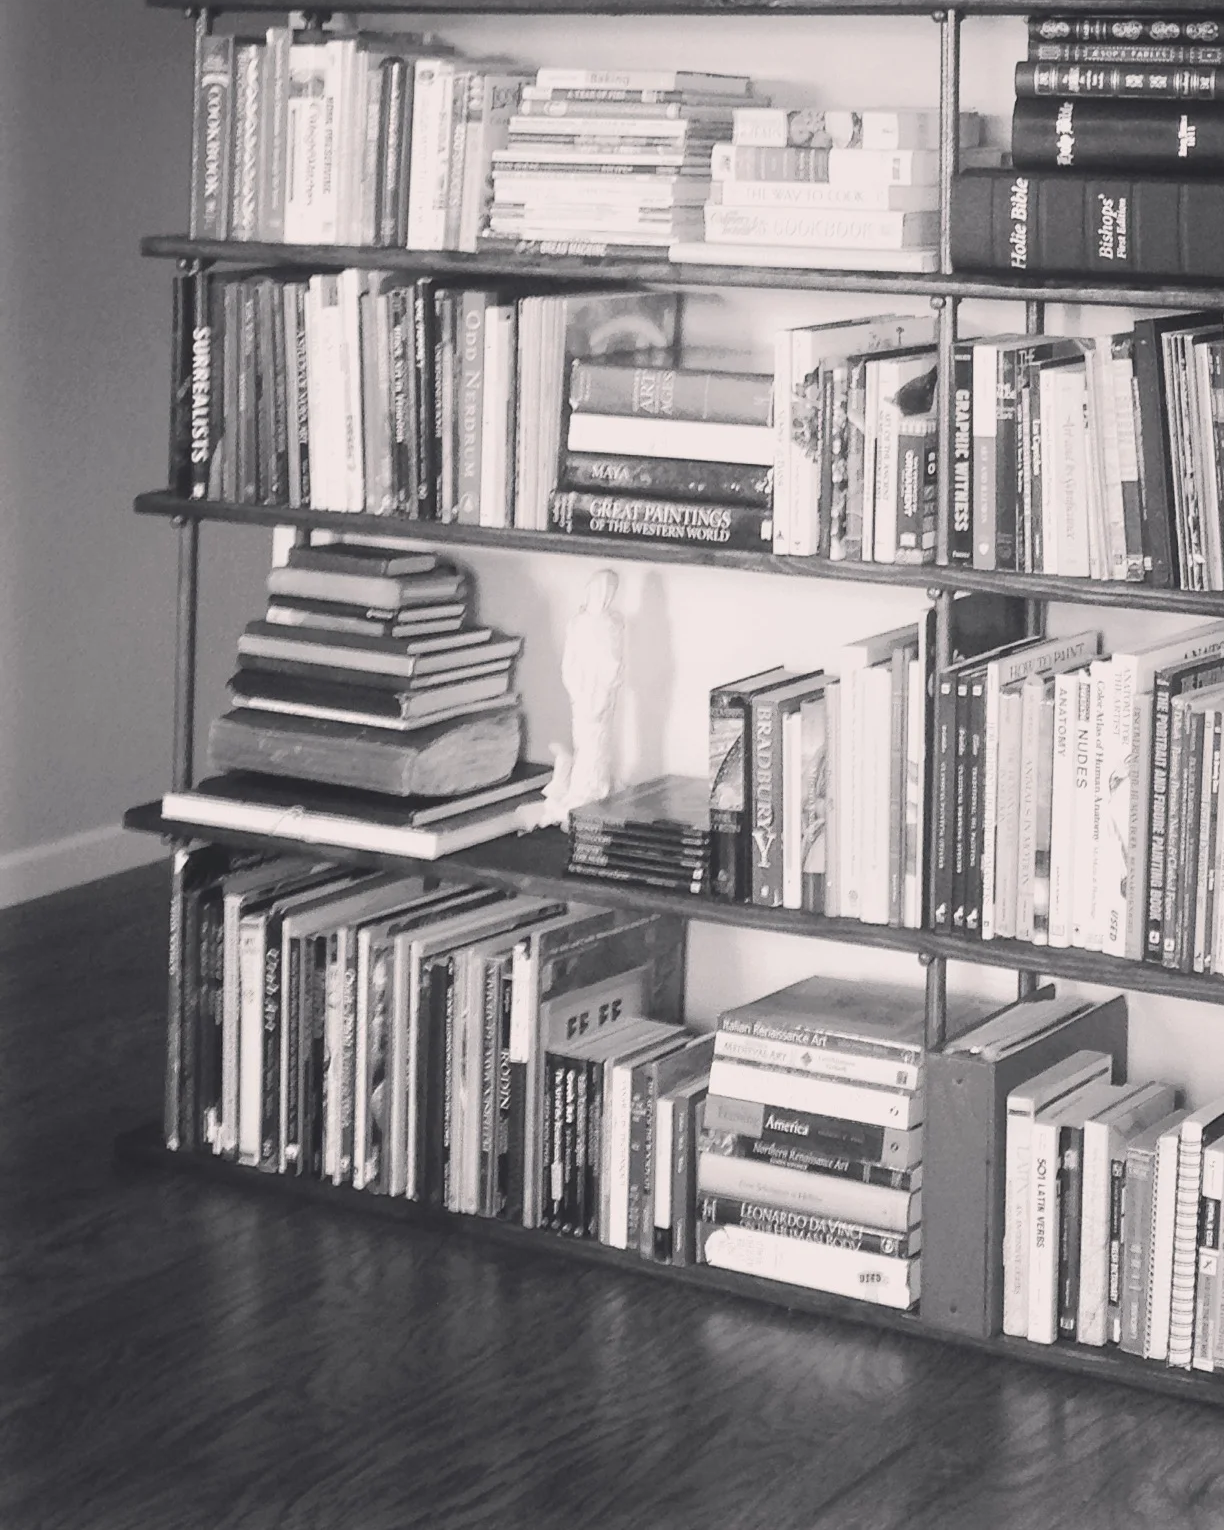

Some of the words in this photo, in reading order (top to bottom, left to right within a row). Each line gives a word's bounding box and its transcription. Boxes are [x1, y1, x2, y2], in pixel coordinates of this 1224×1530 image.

[1011, 177, 1029, 222] Bible
[1116, 197, 1127, 235] Edition
[1011, 223, 1028, 269] Holie
[1097, 192, 1117, 260] Bishops'
[191, 325, 212, 464] SURREALISTS
[955, 390, 969, 459] GRAPHIC
[591, 463, 629, 480] MAYA
[589, 499, 640, 520] GREAT
[643, 505, 732, 528] PAINTINGS
[954, 462, 970, 531] WITNESS
[589, 519, 604, 530] OF
[608, 520, 629, 532] THE
[628, 522, 685, 538] WESTERN
[687, 527, 731, 542] WORLD
[1157, 691, 1170, 712] THE
[1057, 688, 1068, 758] ANATOMY
[1155, 714, 1168, 767] PORTRAIT
[756, 706, 774, 828] BRADBURY
[1076, 730, 1088, 789] NUDES
[1094, 752, 1103, 793] Human
[1154, 769, 1167, 792] AND
[1153, 794, 1166, 833] FIGURE
[1150, 835, 1165, 888] PAINTING
[1149, 890, 1163, 920] BOOK
[722, 1020, 753, 1034] Italian
[753, 1022, 808, 1046] Renaissance
[809, 1032, 828, 1047] Art
[500, 1050, 511, 1110] RODIN
[765, 1114, 810, 1137] America
[1036, 1183, 1046, 1213] LATIN
[740, 1202, 811, 1230] LEONARDO
[810, 1217, 828, 1233] DA
[828, 1220, 864, 1239] VINCI
[1036, 1216, 1045, 1249] VERBS
